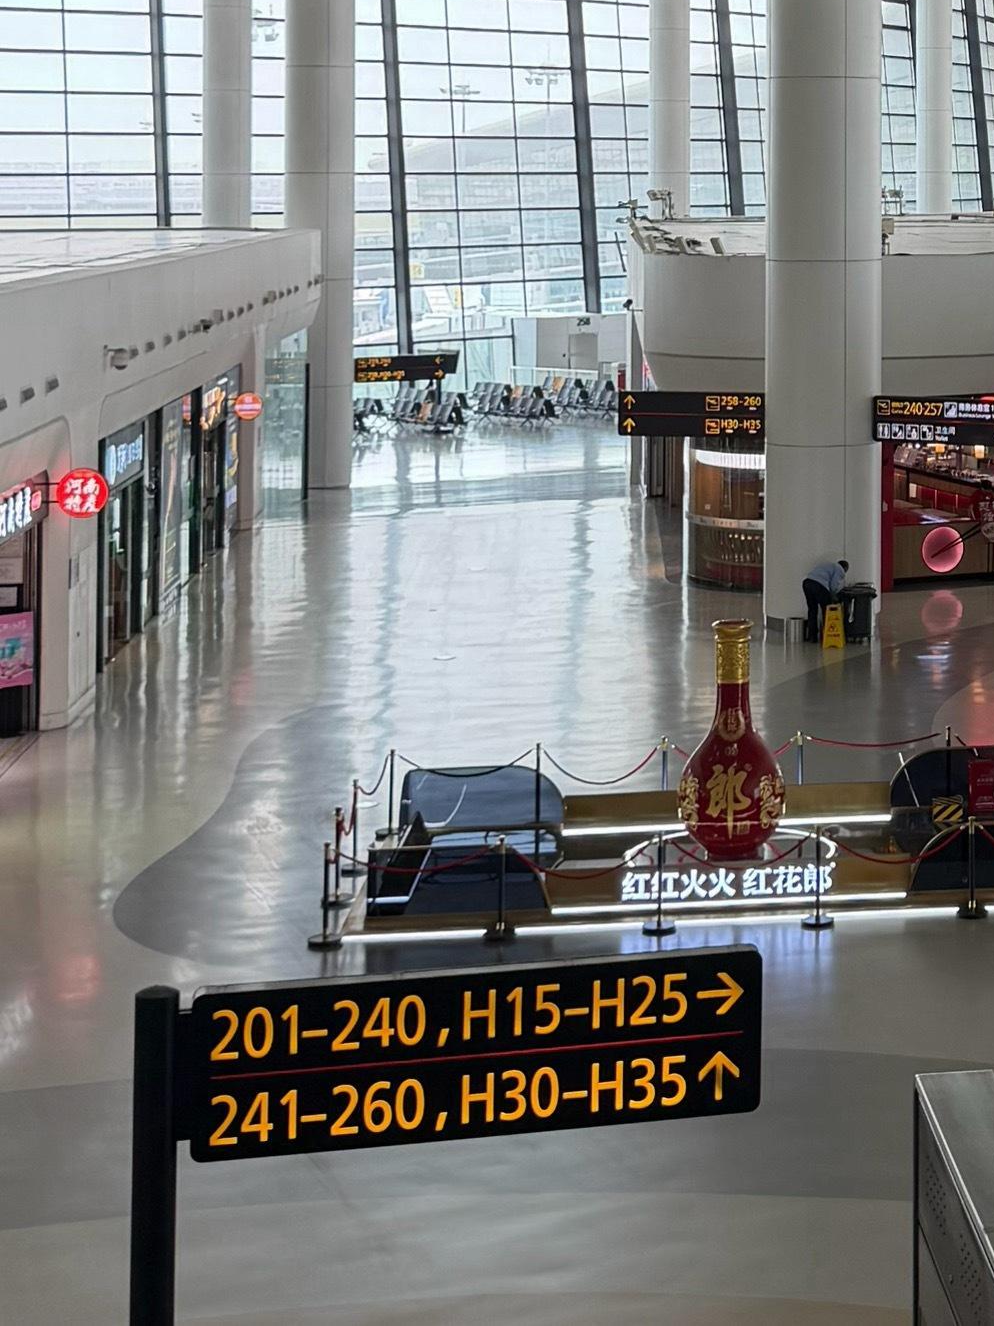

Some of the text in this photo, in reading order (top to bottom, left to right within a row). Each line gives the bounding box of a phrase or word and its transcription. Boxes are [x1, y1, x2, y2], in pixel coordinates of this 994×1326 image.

[577, 317, 591, 326] 258
[720, 396, 762, 407] 258-260
[903, 402, 944, 417] 240-257
[720, 419, 762, 429] H30-H35
[64, 478, 100, 496] 河南
[705, 761, 752, 841] 郎
[621, 863, 834, 902] 红红火火 红花郎
